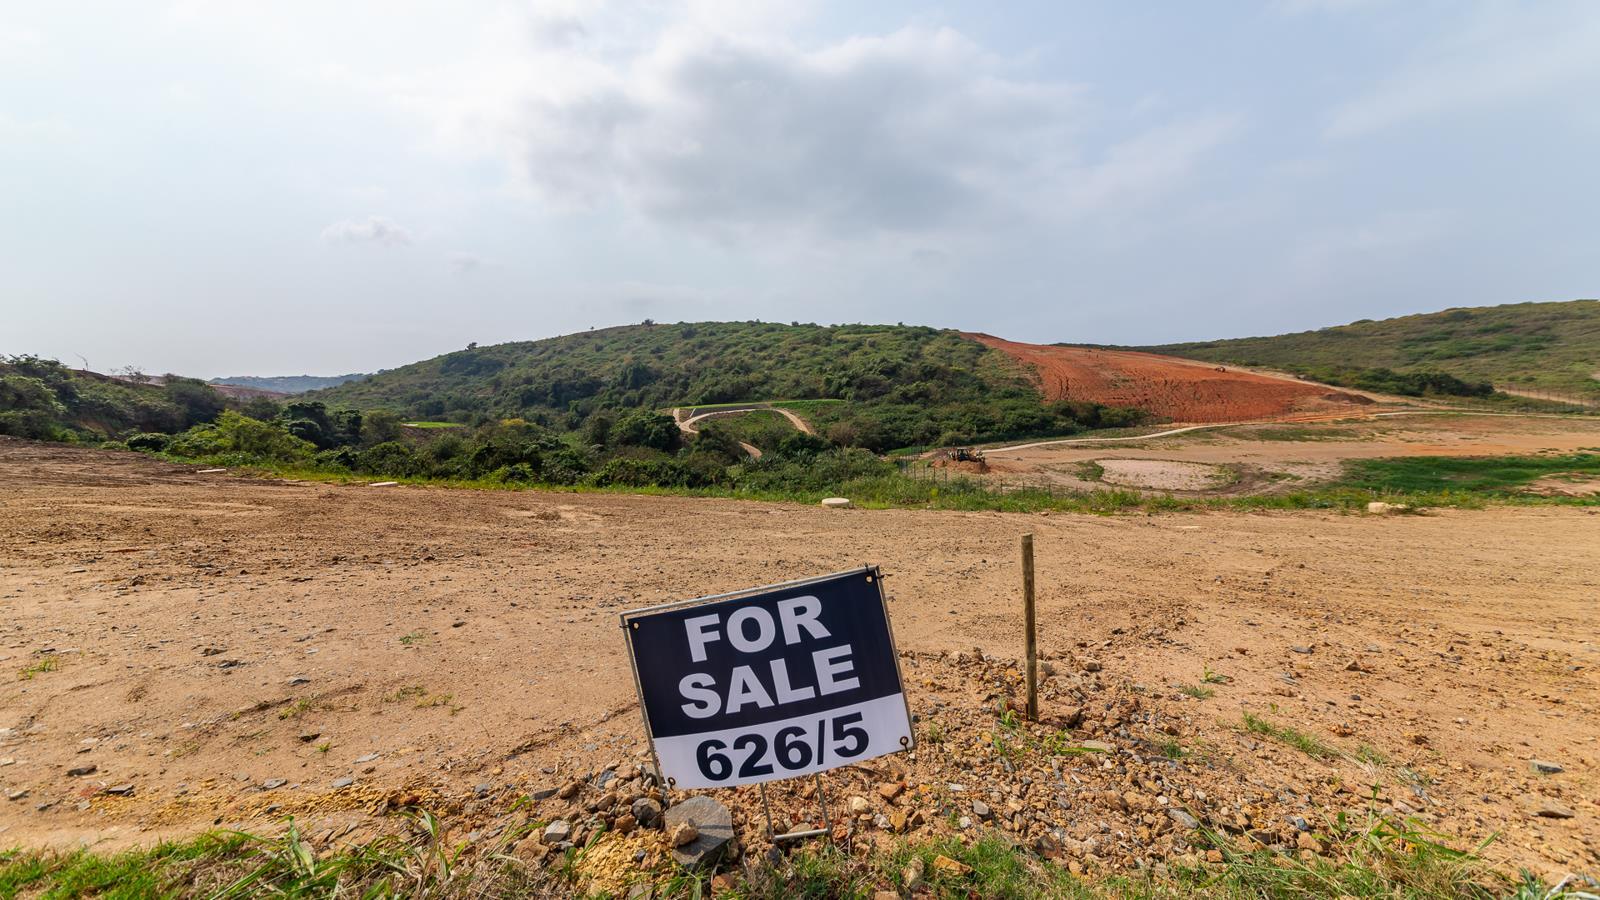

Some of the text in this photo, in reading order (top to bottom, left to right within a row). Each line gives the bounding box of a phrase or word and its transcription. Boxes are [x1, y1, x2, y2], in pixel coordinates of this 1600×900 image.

[684, 595, 831, 663] FOR
[678, 644, 860, 719] SALE
[696, 711, 870, 781] 626/5
